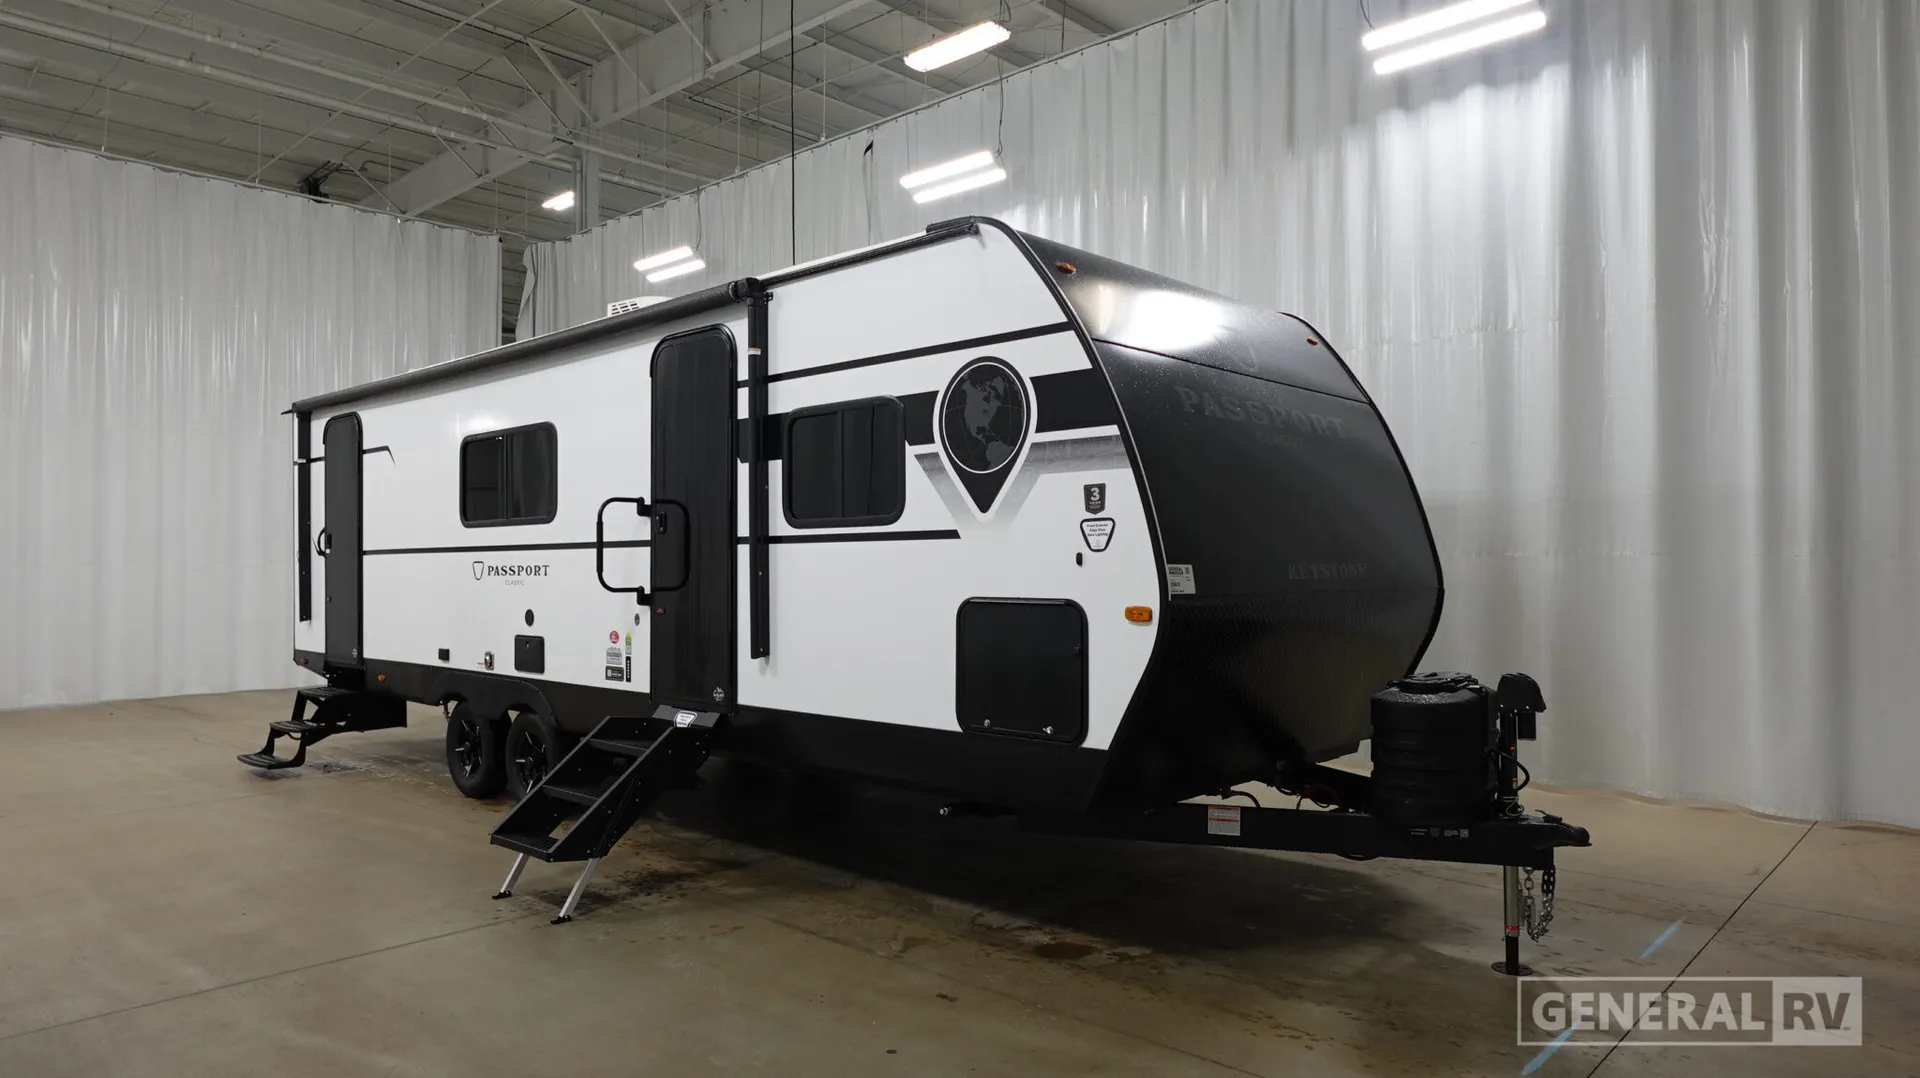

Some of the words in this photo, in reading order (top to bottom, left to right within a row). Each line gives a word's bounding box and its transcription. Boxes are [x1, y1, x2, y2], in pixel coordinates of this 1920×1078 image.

[1174, 385, 1346, 439] PASSPORT
[1090, 487, 1100, 501] 3
[487, 565, 550, 576] PASSPORT
[1287, 562, 1368, 580] KEYSTONE
